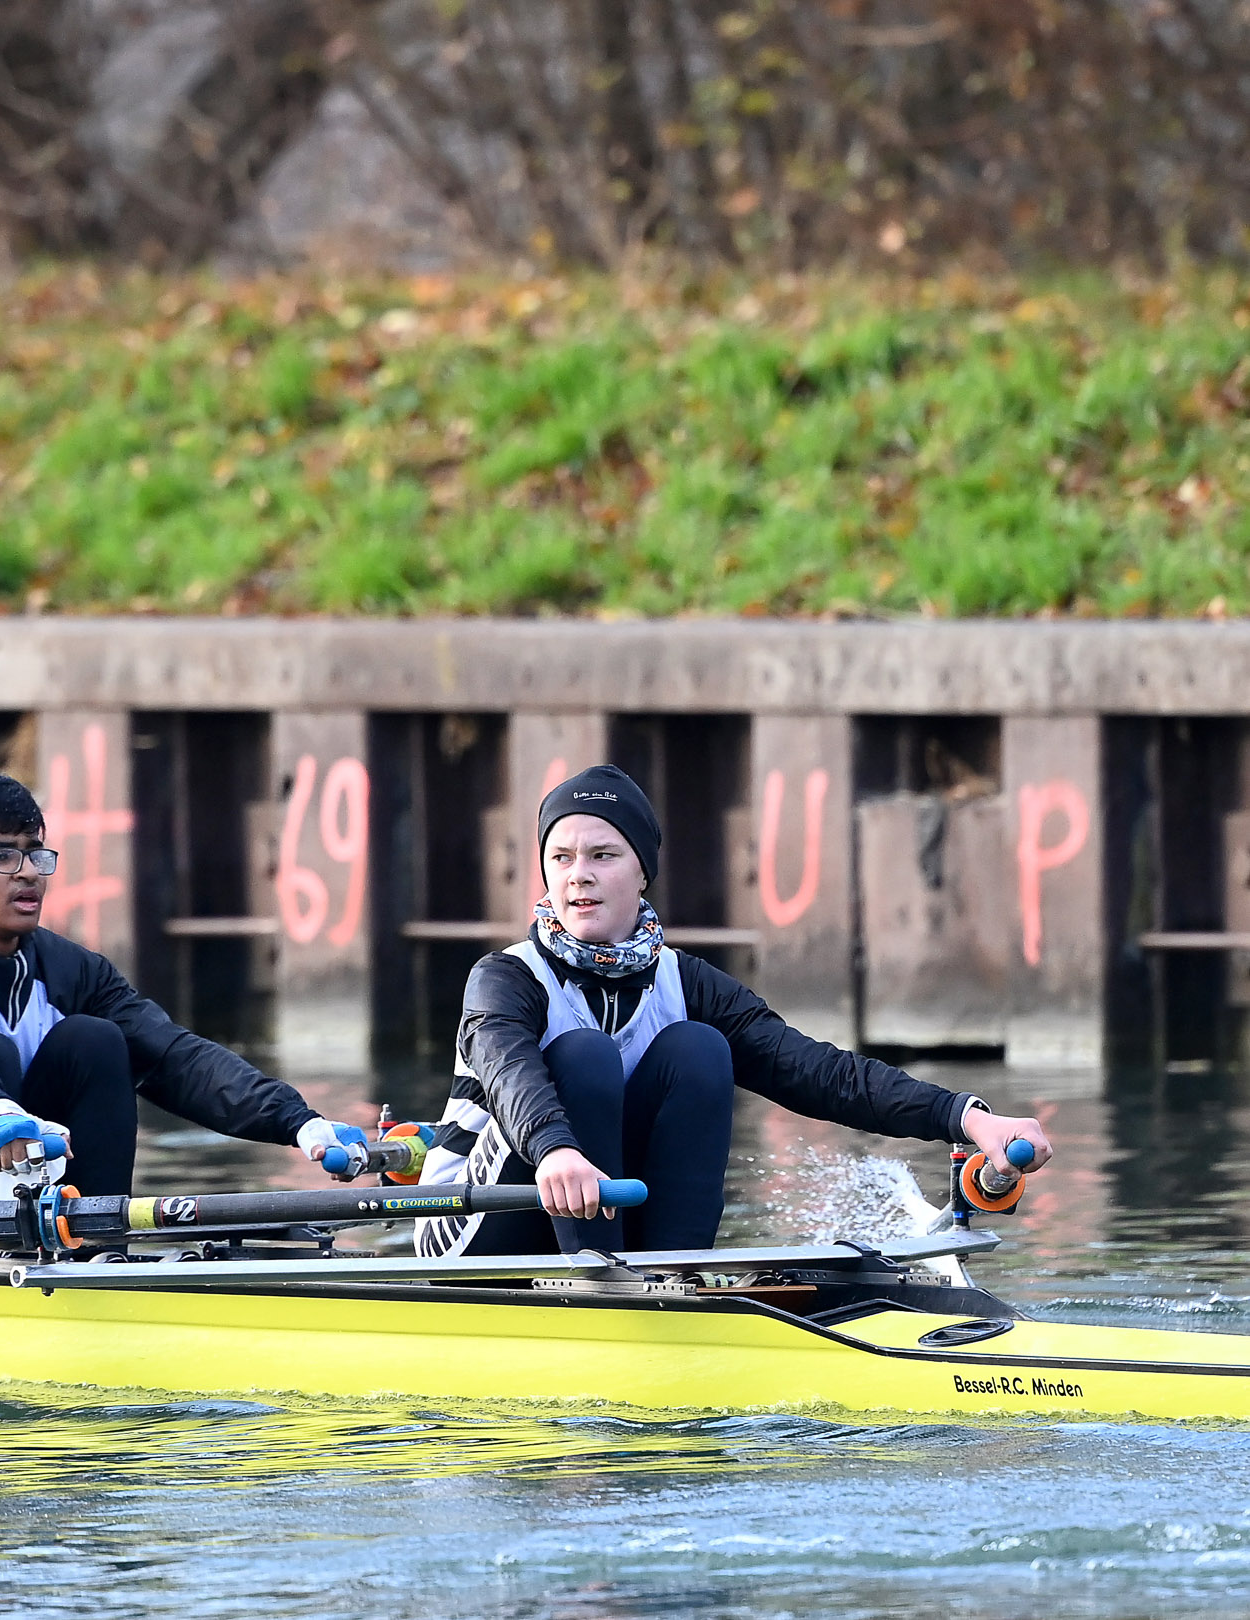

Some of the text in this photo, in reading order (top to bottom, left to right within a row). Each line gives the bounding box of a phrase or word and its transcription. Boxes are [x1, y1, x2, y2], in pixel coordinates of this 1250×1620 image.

[276, 754, 370, 946] 69
[953, 1375, 1083, 1397] Bessel-R.C. Minden
